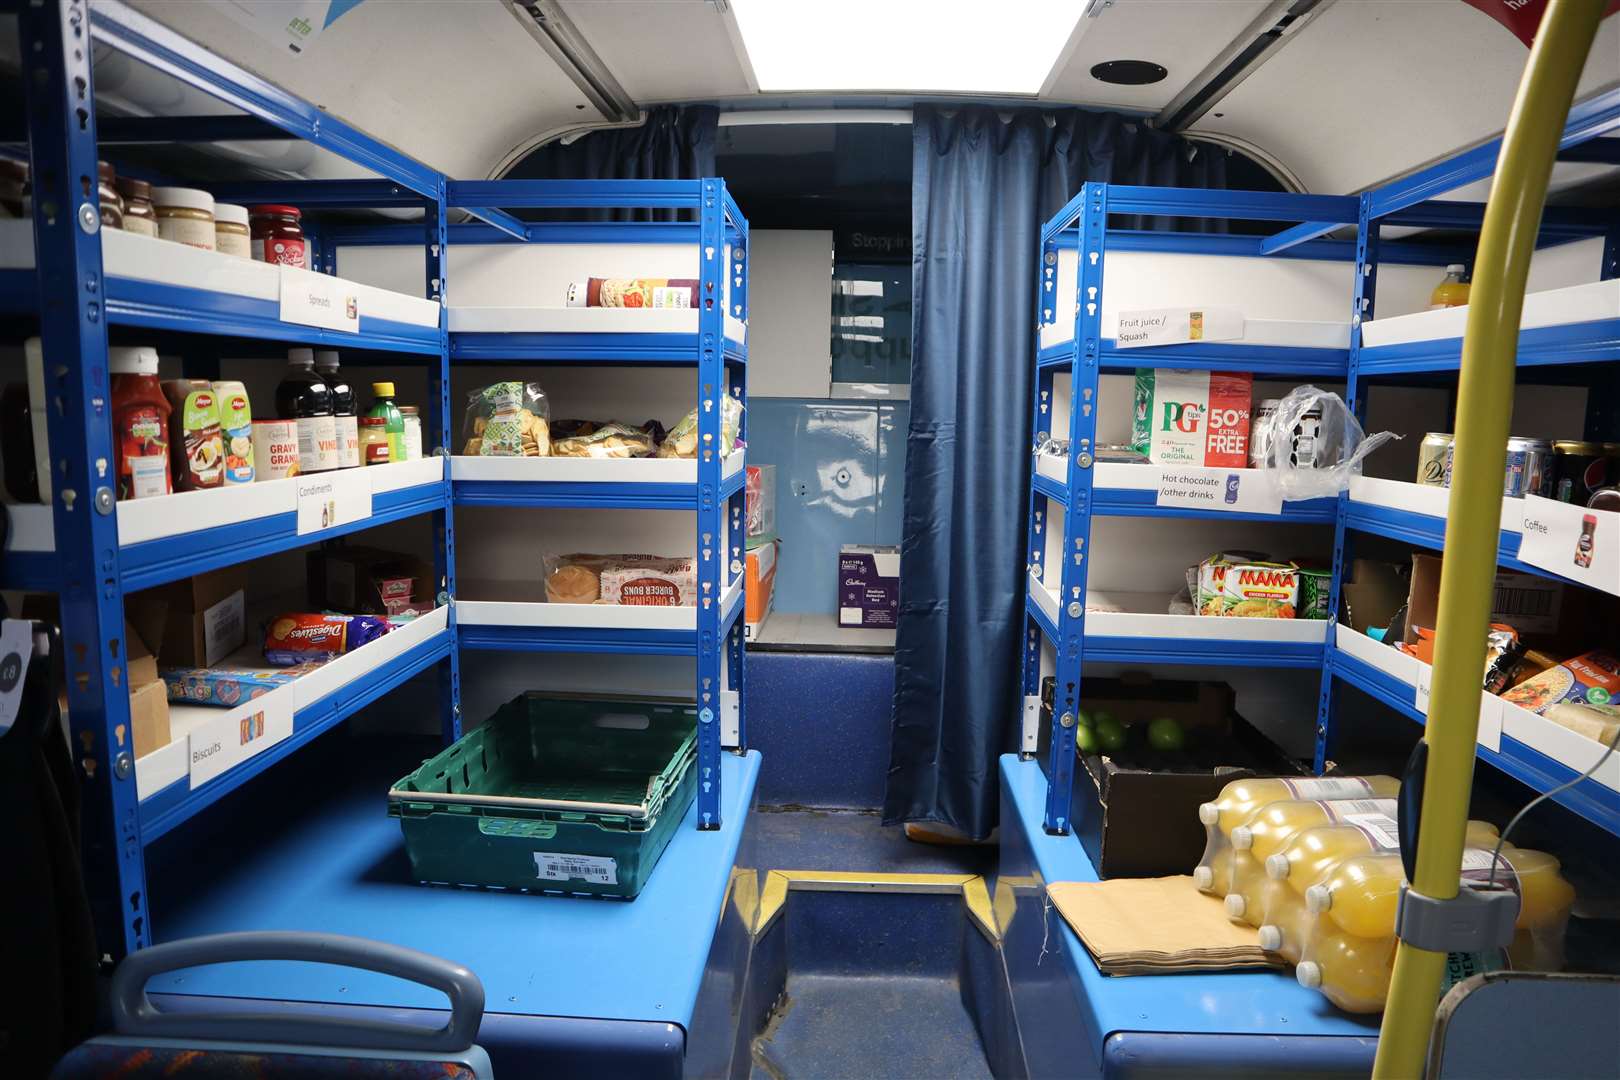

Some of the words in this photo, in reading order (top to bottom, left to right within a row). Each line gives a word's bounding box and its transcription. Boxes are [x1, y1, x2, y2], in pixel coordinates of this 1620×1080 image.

[309, 293, 330, 308] Spreads
[1120, 319, 1139, 327] Fruit
[1141, 318, 1160, 327] juice
[1120, 332, 1148, 342] Squash
[1160, 401, 1201, 433] PG
[1208, 408, 1250, 429] 50%
[1218, 428, 1240, 436] EXTRA
[271, 444, 297, 454] GRAVY
[1172, 446, 1185, 454] THE
[1207, 434, 1247, 455] FREE
[1160, 452, 1195, 461] ORIGINAL
[1162, 474, 1178, 483] Hot
[1180, 474, 1220, 486] chocolate
[299, 483, 333, 498] Condiments
[1160, 487, 1187, 497] /other
[1188, 490, 1214, 499] drinks
[1524, 518, 1548, 534] Coffee
[1238, 569, 1296, 588] MAMA
[624, 586, 644, 596] BUNS
[645, 586, 674, 596] BURGER
[290, 623, 342, 639] Digestives
[192, 742, 222, 764] Biscuits
